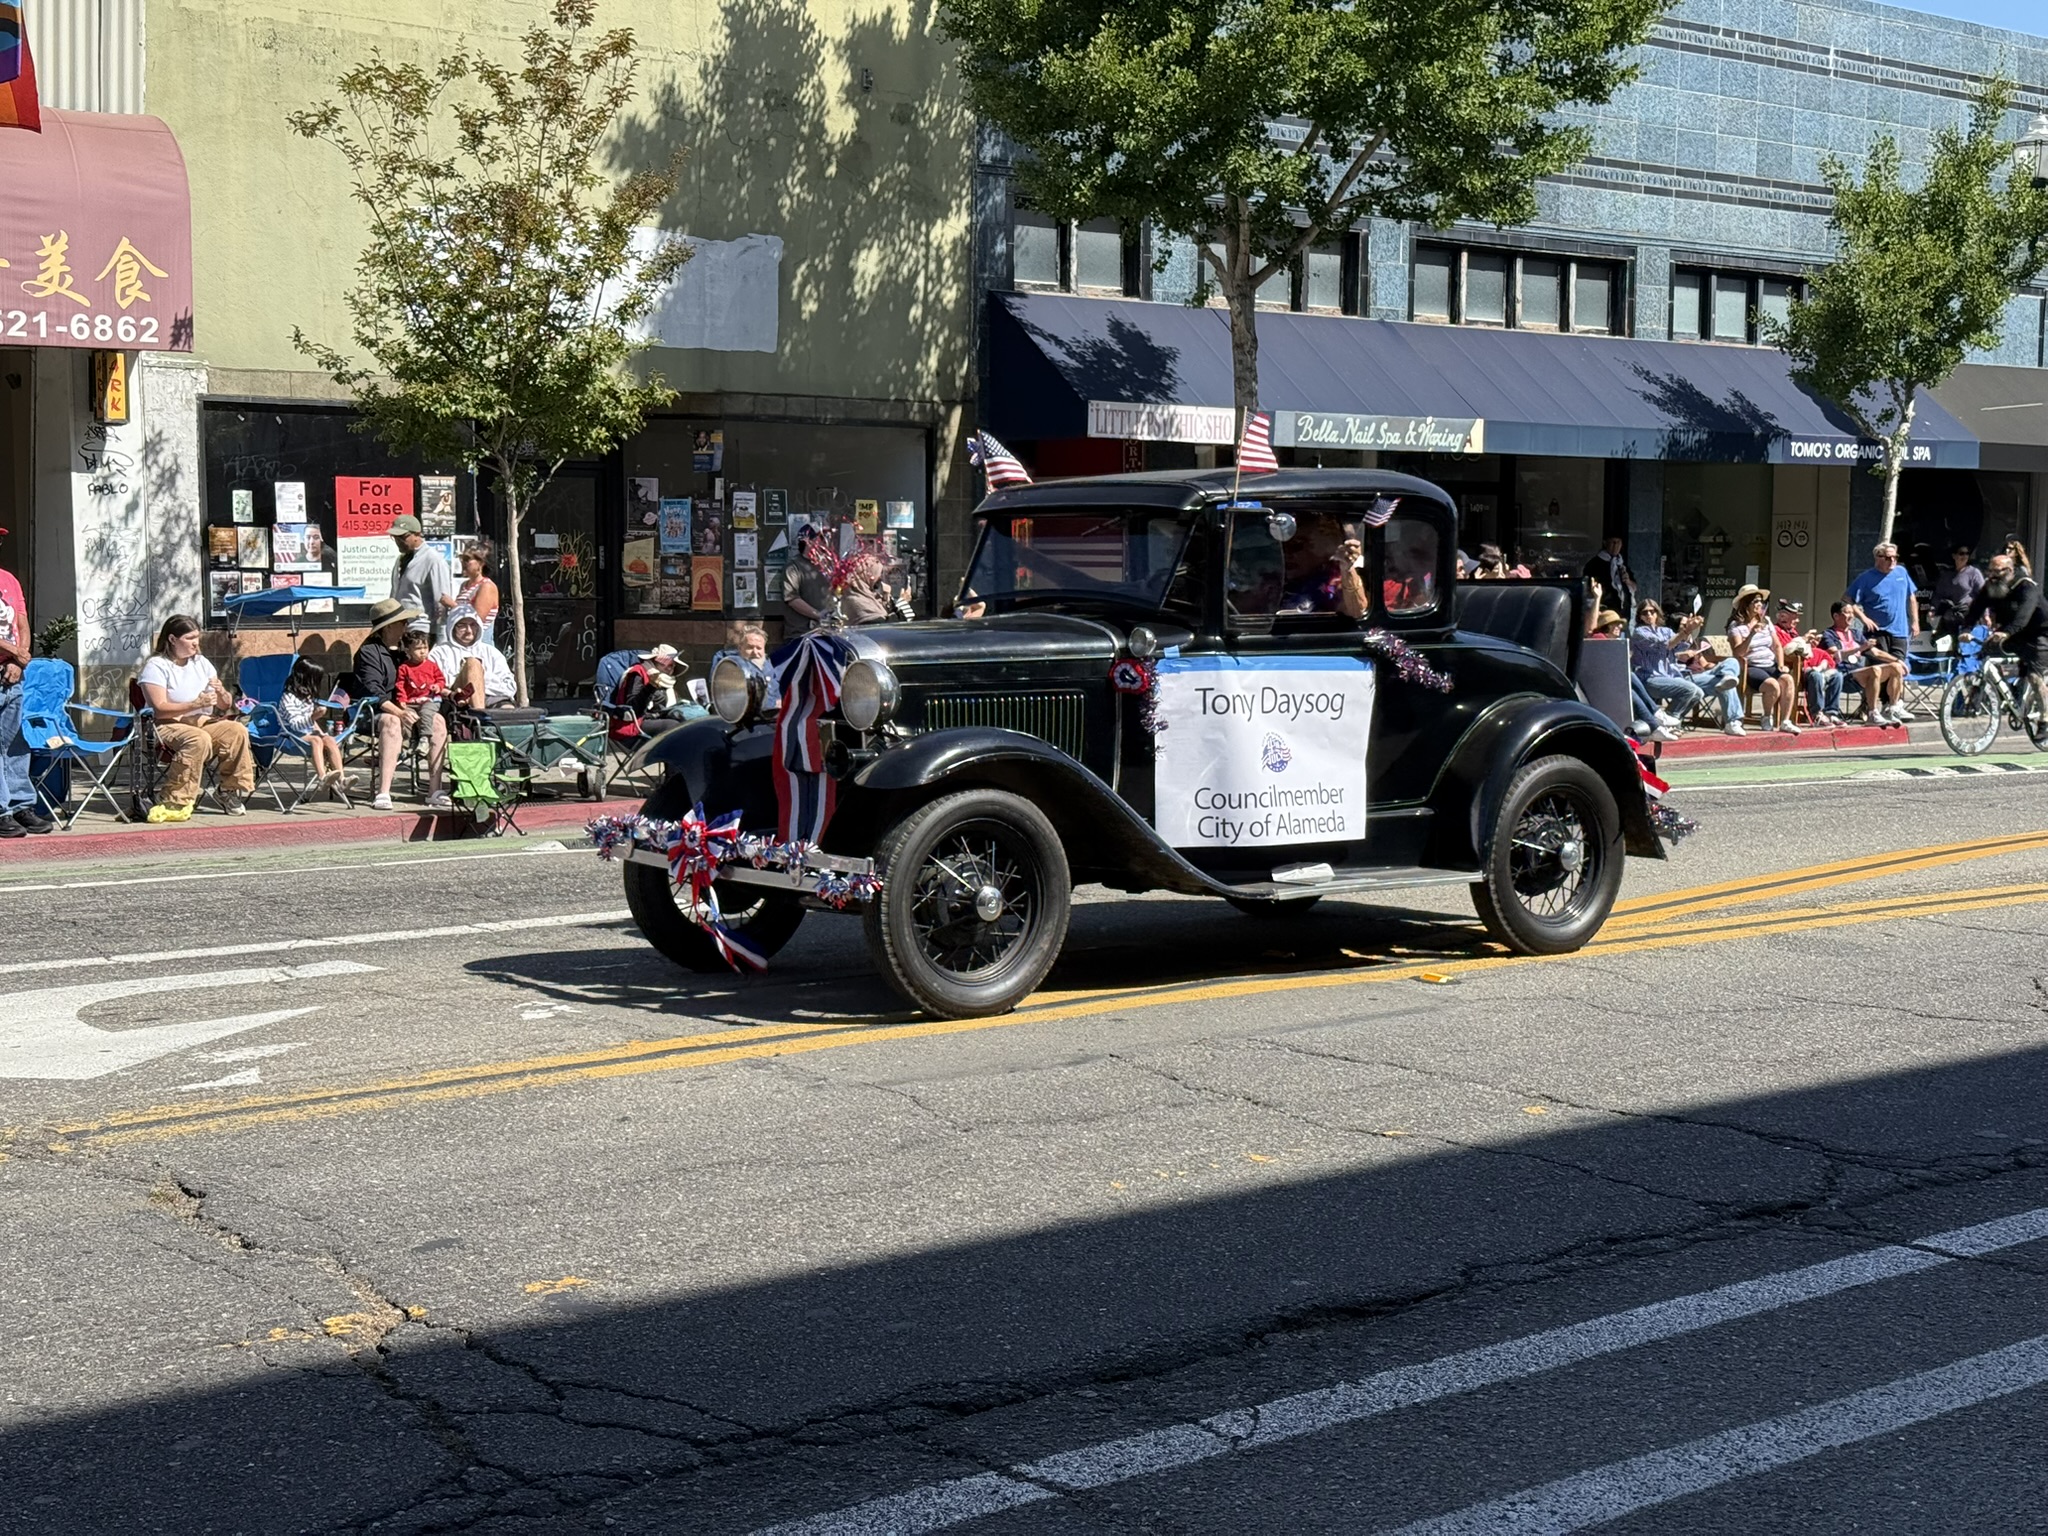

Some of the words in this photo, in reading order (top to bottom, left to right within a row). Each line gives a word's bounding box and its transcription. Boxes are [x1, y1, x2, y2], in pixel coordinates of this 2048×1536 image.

[0, 229, 169, 310] 美食
[0, 309, 160, 343] 21-6862
[1095, 408, 1144, 436] LITTLE
[1147, 410, 1203, 440] PSYCHIC
[1205, 413, 1233, 441] SHO
[1297, 415, 1340, 443] Bella
[1340, 416, 1375, 444] Nail
[1377, 422, 1401, 449] Spa
[1405, 420, 1417, 446] &
[1418, 421, 1464, 452] Waxing
[1791, 441, 1832, 458] TOMO'S
[1835, 443, 1884, 460] ORGANIC
[1913, 446, 1932, 461] SPA
[87, 482, 128, 496] PABLO
[360, 480, 391, 497] For
[348, 499, 403, 515] Lease
[341, 545, 367, 553] Justin
[370, 545, 389, 553] Choi
[341, 566, 357, 575] Jeff
[359, 566, 391, 575] Badstub
[1194, 687, 1255, 722] Tony
[1261, 687, 1345, 721] Daysog
[1194, 782, 1345, 810] Councilmember
[1197, 815, 1244, 844] City
[1250, 813, 1271, 838] of
[1276, 810, 1346, 836] Alameda
